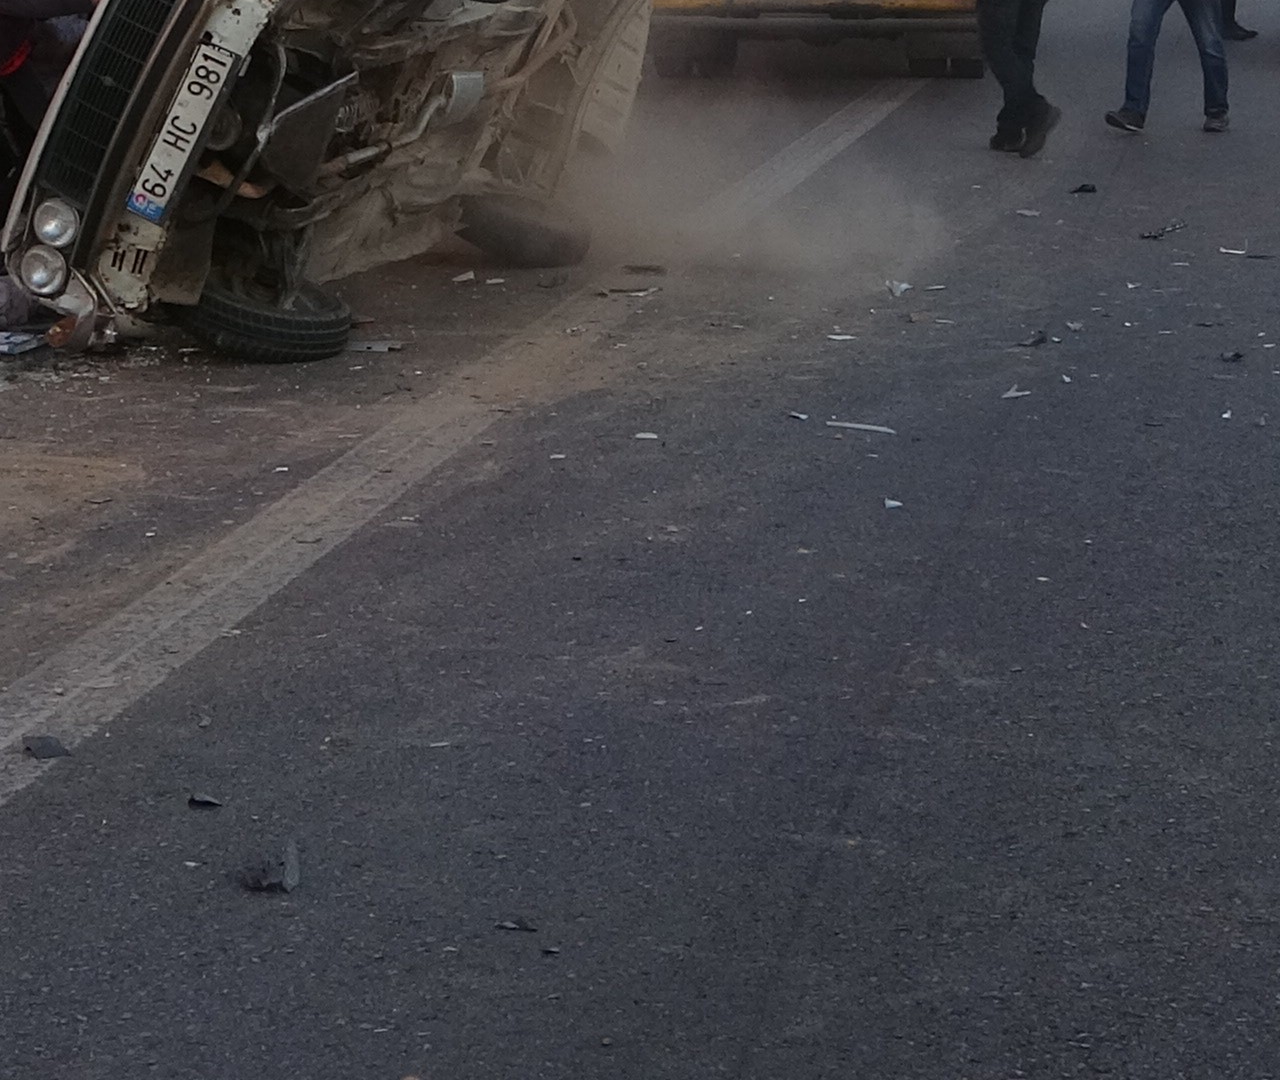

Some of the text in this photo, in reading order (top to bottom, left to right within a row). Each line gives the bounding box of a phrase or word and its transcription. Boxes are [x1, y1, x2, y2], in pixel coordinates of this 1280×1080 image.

[141, 163, 174, 198] 64
[162, 115, 197, 153] HC
[187, 52, 227, 101] 981
